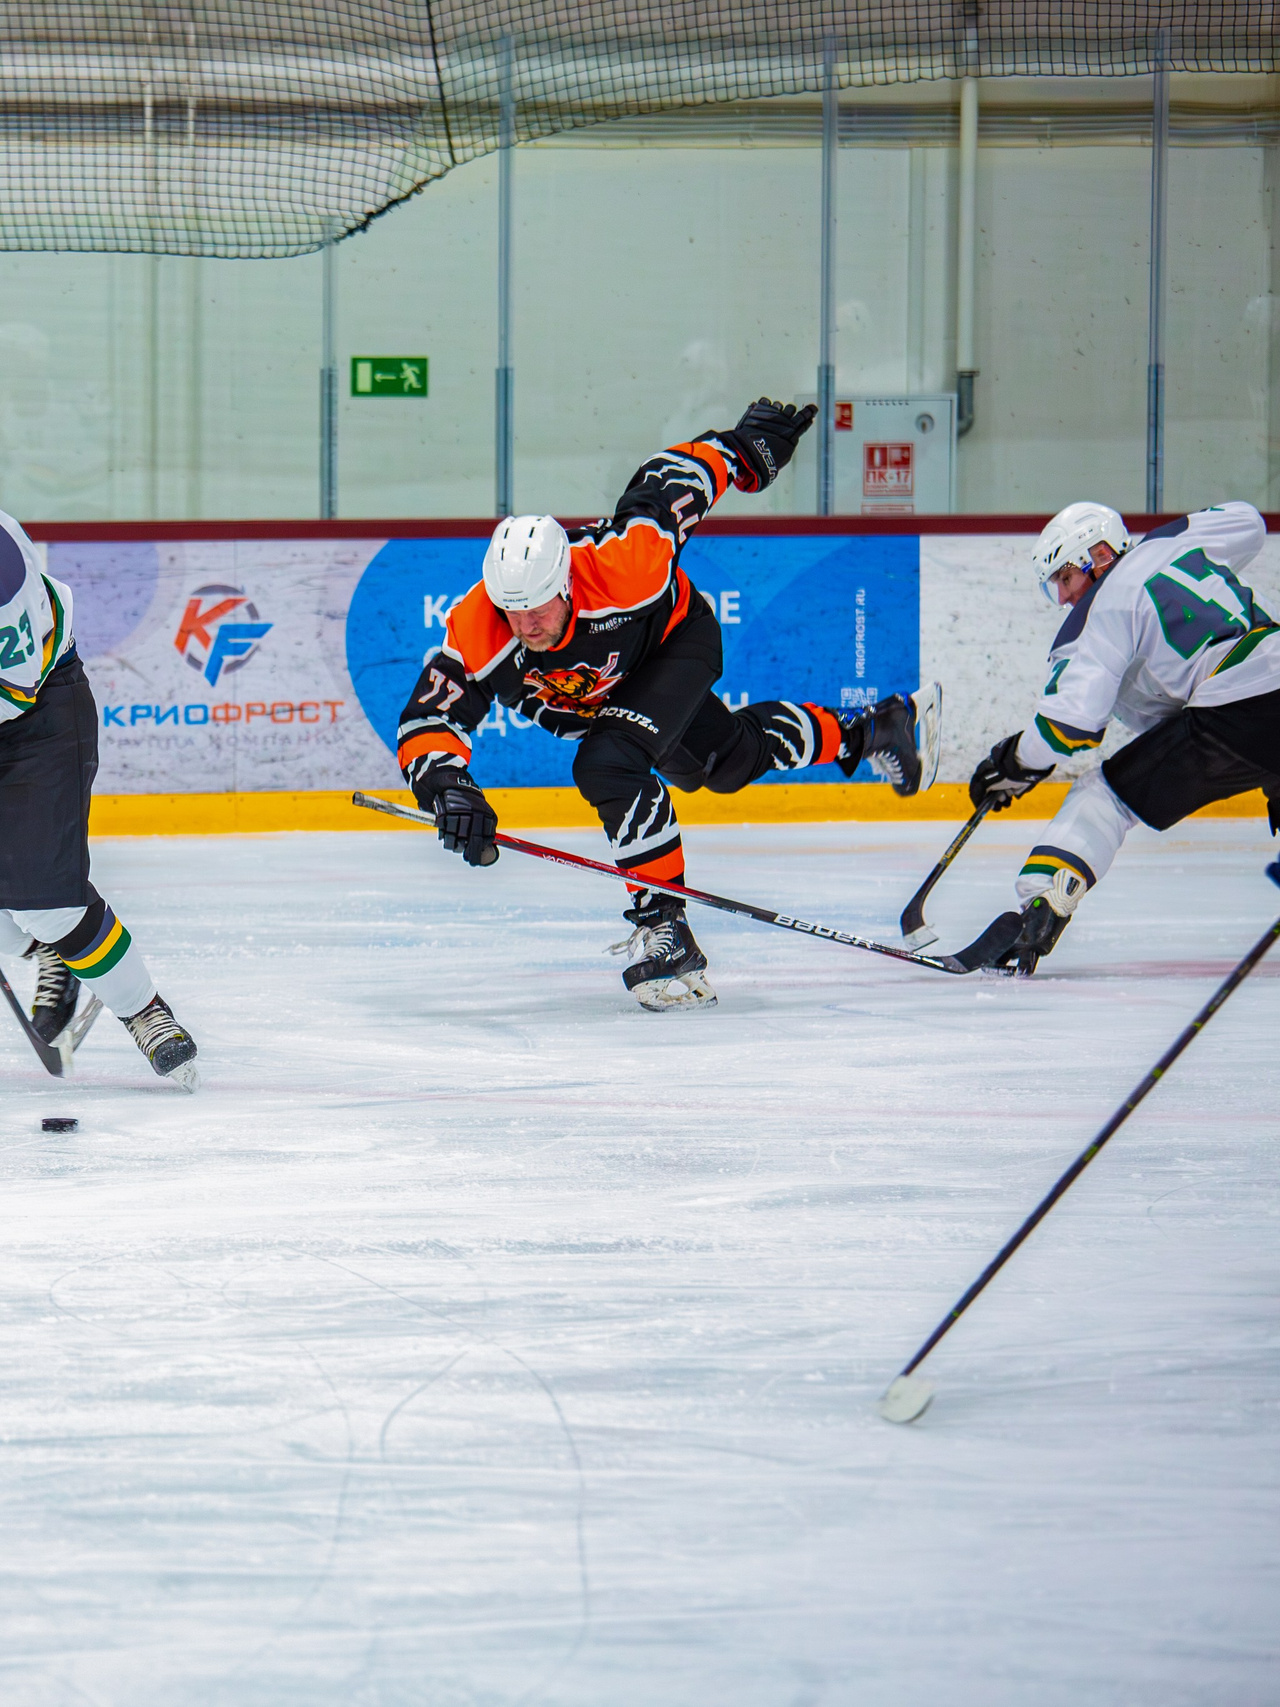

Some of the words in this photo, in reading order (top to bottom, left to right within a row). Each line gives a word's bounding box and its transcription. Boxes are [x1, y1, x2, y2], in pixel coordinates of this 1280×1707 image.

[855, 588, 866, 679] KRIOFROST.RU
[418, 667, 465, 712] 77
[103, 701, 345, 727] КРИОФРОСТ
[773, 913, 875, 949] BAUER
